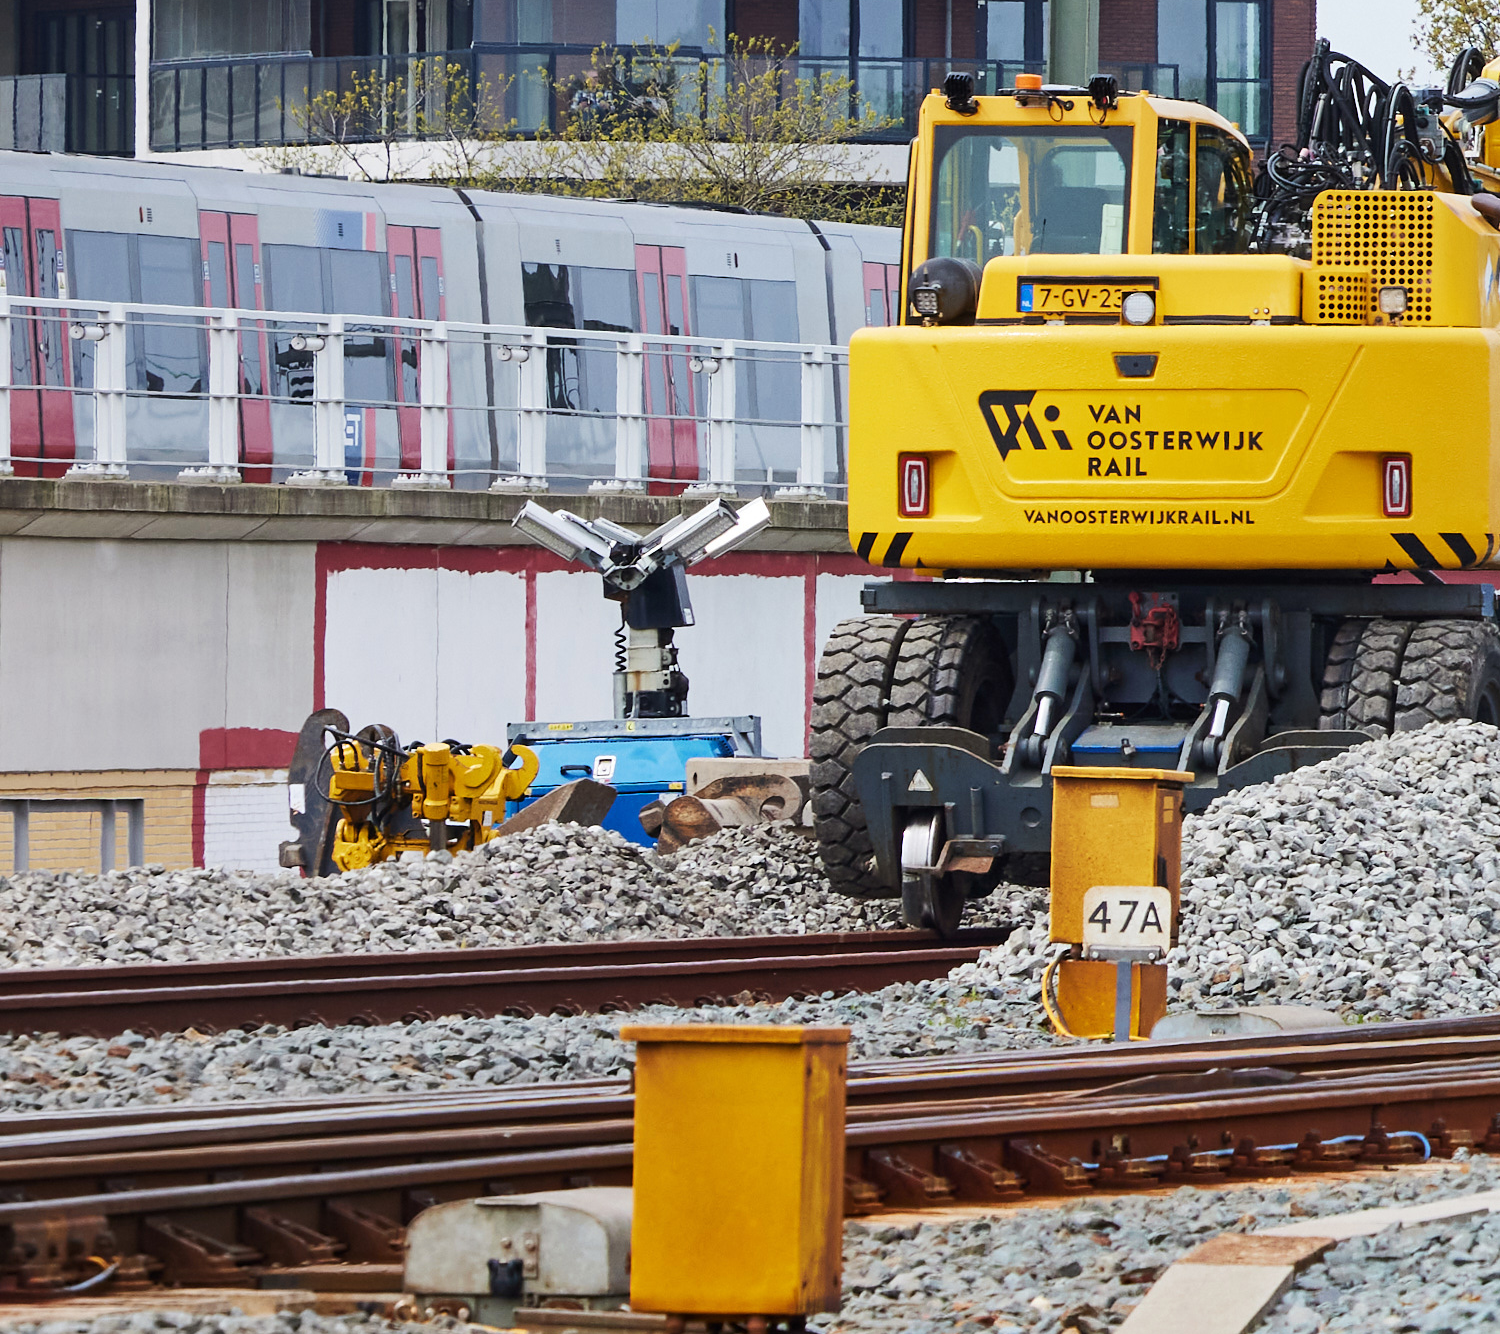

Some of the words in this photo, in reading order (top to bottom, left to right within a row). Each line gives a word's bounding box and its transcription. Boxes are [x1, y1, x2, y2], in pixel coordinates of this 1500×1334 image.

[1040, 288, 1139, 308] 7-GV-23
[1088, 404, 1141, 424] VAN
[1087, 431, 1264, 451] OOSTERWIJK
[1088, 457, 1148, 476] RAIL
[1024, 510, 1255, 524] VANOOSTERWIJKRAIL.NL
[1088, 900, 1163, 934] 47A
